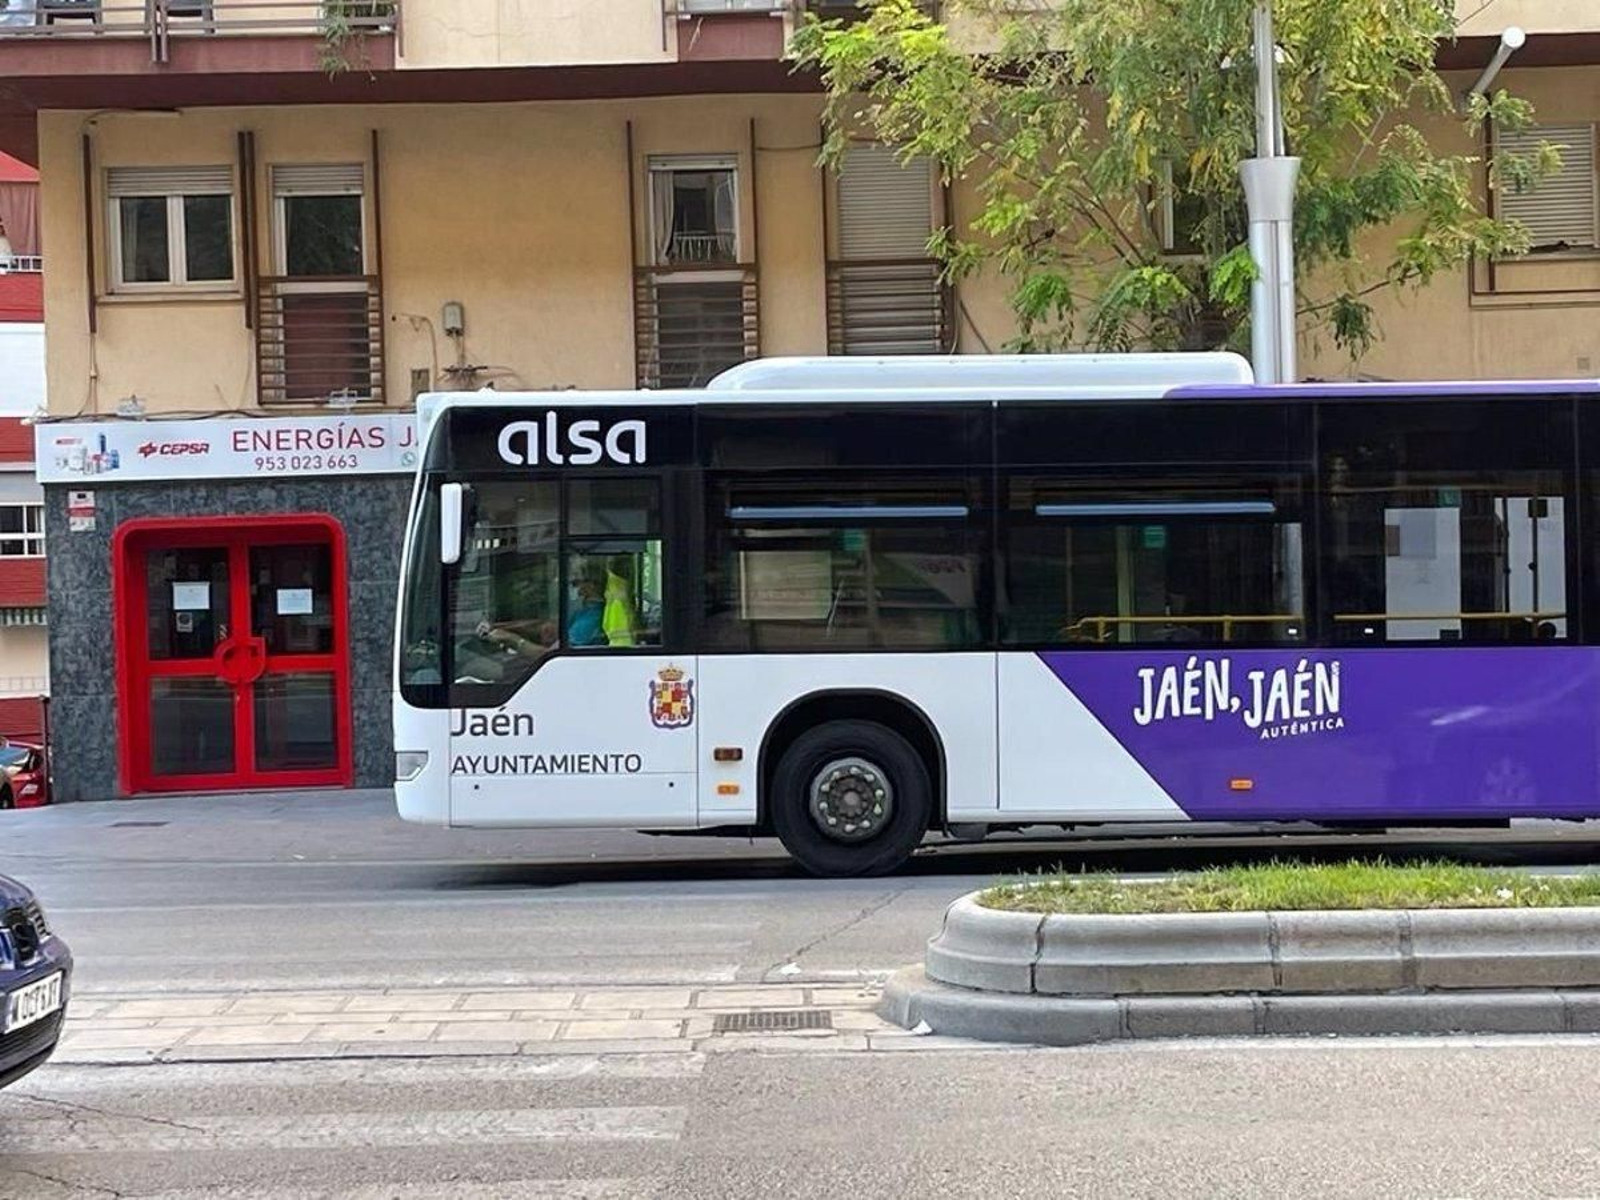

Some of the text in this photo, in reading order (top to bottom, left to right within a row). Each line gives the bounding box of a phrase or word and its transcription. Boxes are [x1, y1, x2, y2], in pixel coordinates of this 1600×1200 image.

[159, 442, 210, 456] CEPSA
[233, 422, 418, 452] ENERGÍAS J
[498, 410, 646, 465] alsa
[255, 454, 358, 471] 953 023 663
[1133, 656, 1341, 729] JAÉN, JAÉN
[450, 706, 534, 737] Jaén
[1260, 716, 1345, 740] AUTÉNTICA
[451, 753, 642, 775] AYUNTAMIENTO
